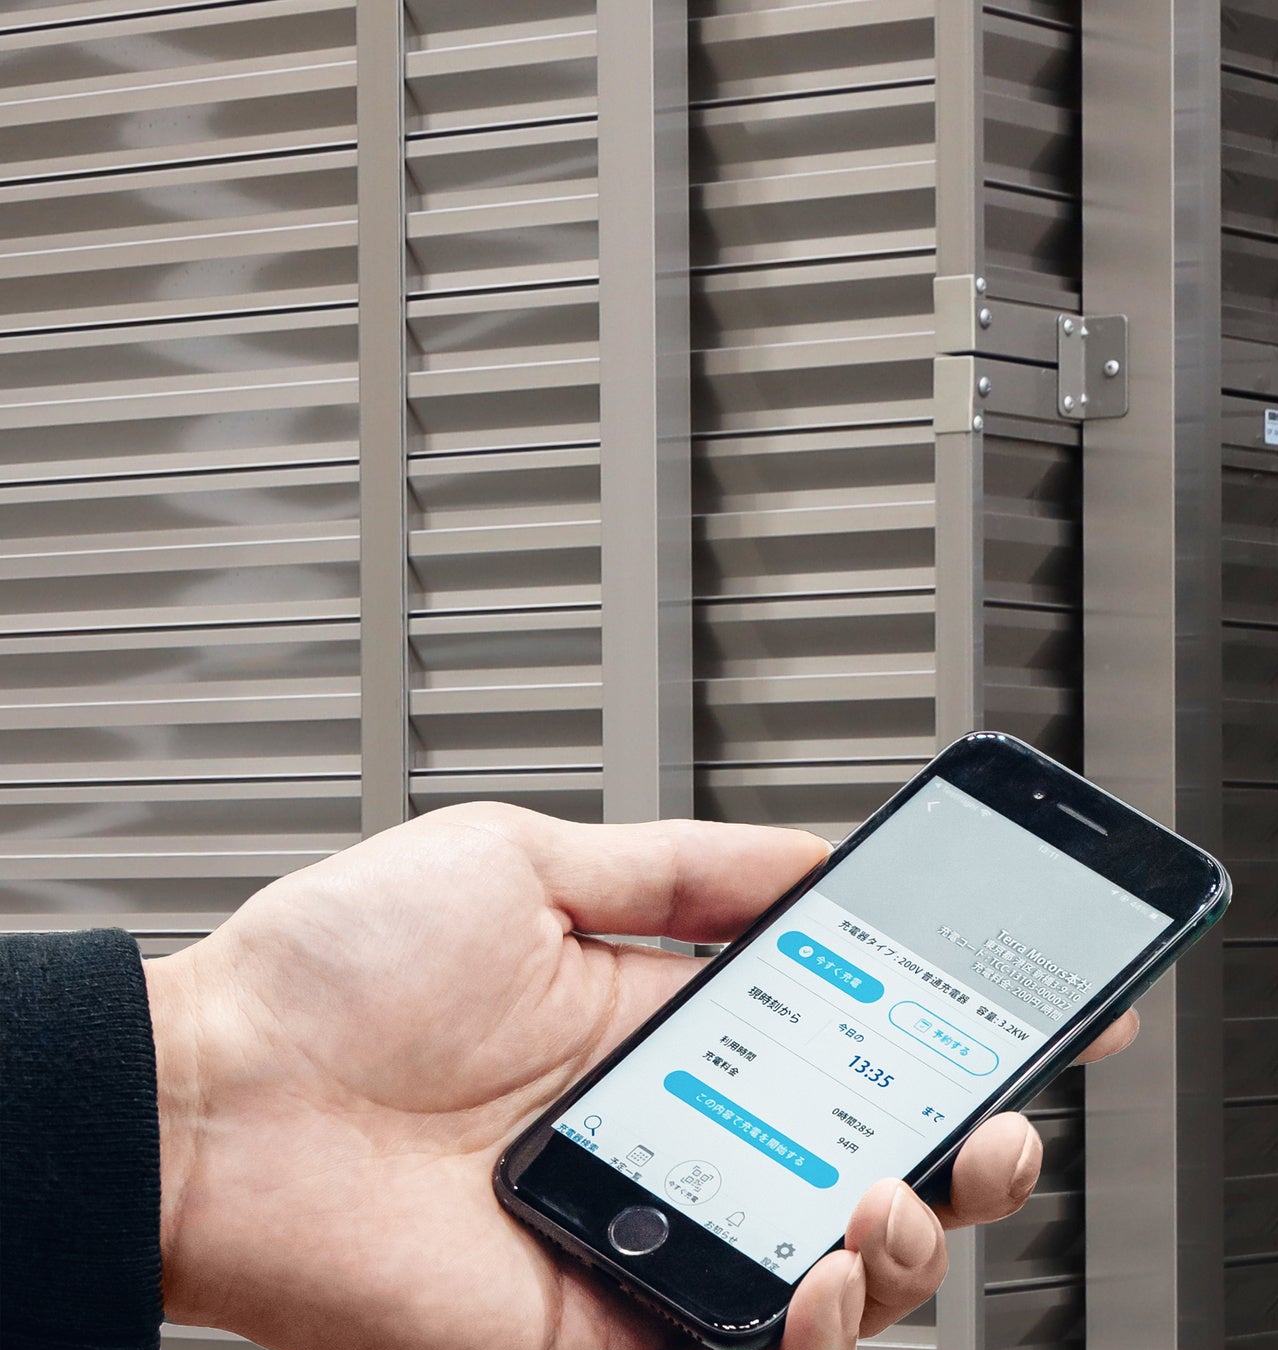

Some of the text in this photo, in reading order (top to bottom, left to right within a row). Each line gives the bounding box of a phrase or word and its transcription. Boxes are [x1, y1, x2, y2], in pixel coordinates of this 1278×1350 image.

[995, 929, 1093, 994] Terra Motors本社
[896, 956, 925, 976] 200V
[919, 970, 971, 1005] 普通充電器
[974, 1004, 1000, 1024] 容量:
[996, 1018, 1030, 1042] 3.2KW
[987, 957, 1073, 1012] TCC-13103-000027
[745, 985, 803, 1024] 現時刻から
[1011, 986, 1063, 1022] 200円/時間
[717, 1034, 758, 1062] 利用時間
[835, 1022, 867, 1044] 今日の
[929, 1028, 972, 1058] 予約する
[700, 1050, 741, 1078] 充電料金
[846, 1054, 896, 1089] 13:35
[692, 1092, 808, 1166] この内容で充電を開始する
[829, 1107, 877, 1139] 0時間28分
[919, 1104, 946, 1124] まで
[554, 1122, 602, 1154] 充電器検索
[834, 1135, 860, 1154] 94円
[606, 1156, 645, 1182] 予定一覧
[701, 1219, 740, 1246] お知らせ
[758, 1255, 782, 1273] 設定
